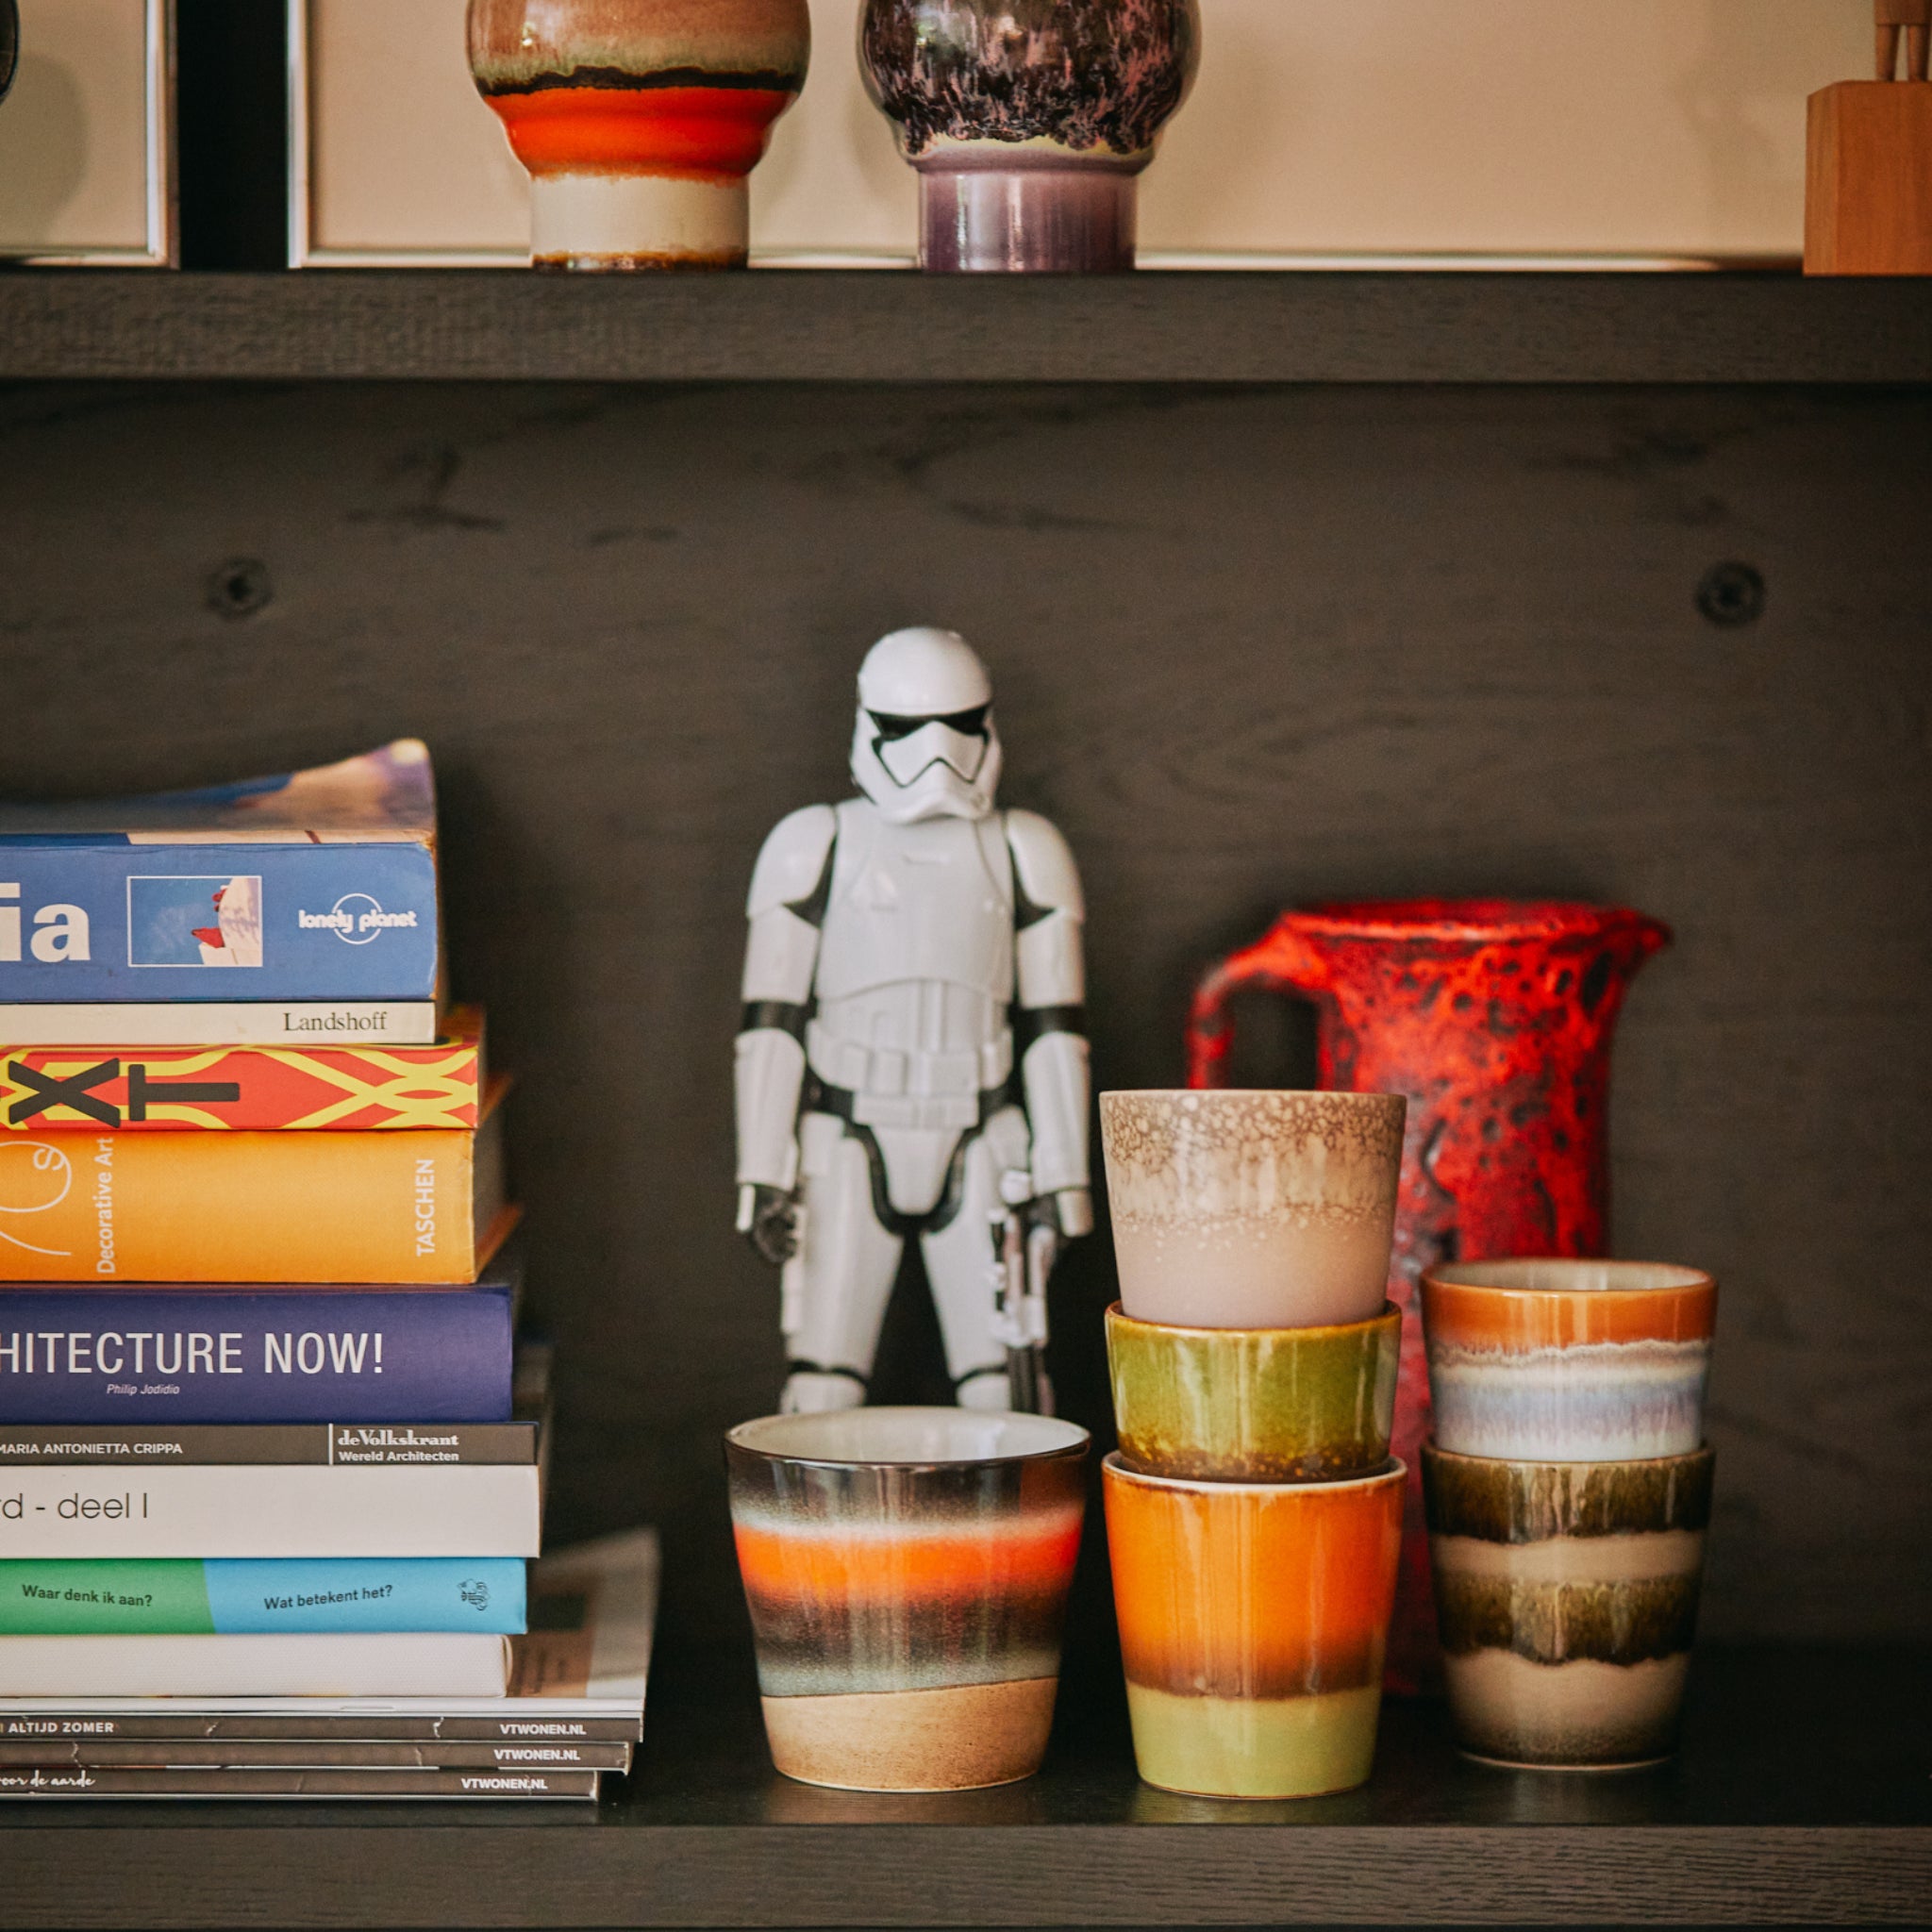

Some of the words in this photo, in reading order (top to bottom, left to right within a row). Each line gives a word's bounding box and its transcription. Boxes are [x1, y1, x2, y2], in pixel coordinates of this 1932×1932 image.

[298, 908, 354, 933] lonely
[358, 908, 418, 933] planet
[284, 1011, 388, 1031] Landshoff
[95, 1137, 114, 1167] Art
[415, 1158, 436, 1257] TASCHEN
[92, 1172, 116, 1274] Decorative
[264, 1332, 383, 1374] NOW!
[107, 1383, 138, 1396] Philip
[141, 1383, 181, 1395] Jodidio
[42, 1442, 131, 1455] ANTONIETTA
[133, 1442, 183, 1455] CRIPPA
[338, 1451, 384, 1461] Wereld
[387, 1451, 459, 1461] Architecten
[0, 1492, 24, 1520] d
[58, 1492, 130, 1520] deel
[22, 1584, 61, 1600] Waar
[64, 1589, 99, 1604] denk
[102, 1591, 115, 1605] ik
[118, 1594, 153, 1607] aan?
[263, 1596, 293, 1610] Wat
[296, 1590, 358, 1607] betekent
[361, 1584, 393, 1601] het?
[8, 1722, 58, 1734] ALTIJD
[62, 1722, 114, 1734] ZOMER
[499, 1724, 588, 1736] VTWONEN.NL
[493, 1749, 581, 1761] VTWONEN.NL
[0, 1776, 28, 1787] oor
[29, 1769, 49, 1788] de
[50, 1769, 96, 1788] aarde
[460, 1777, 549, 1790] VTWONEN.NL
